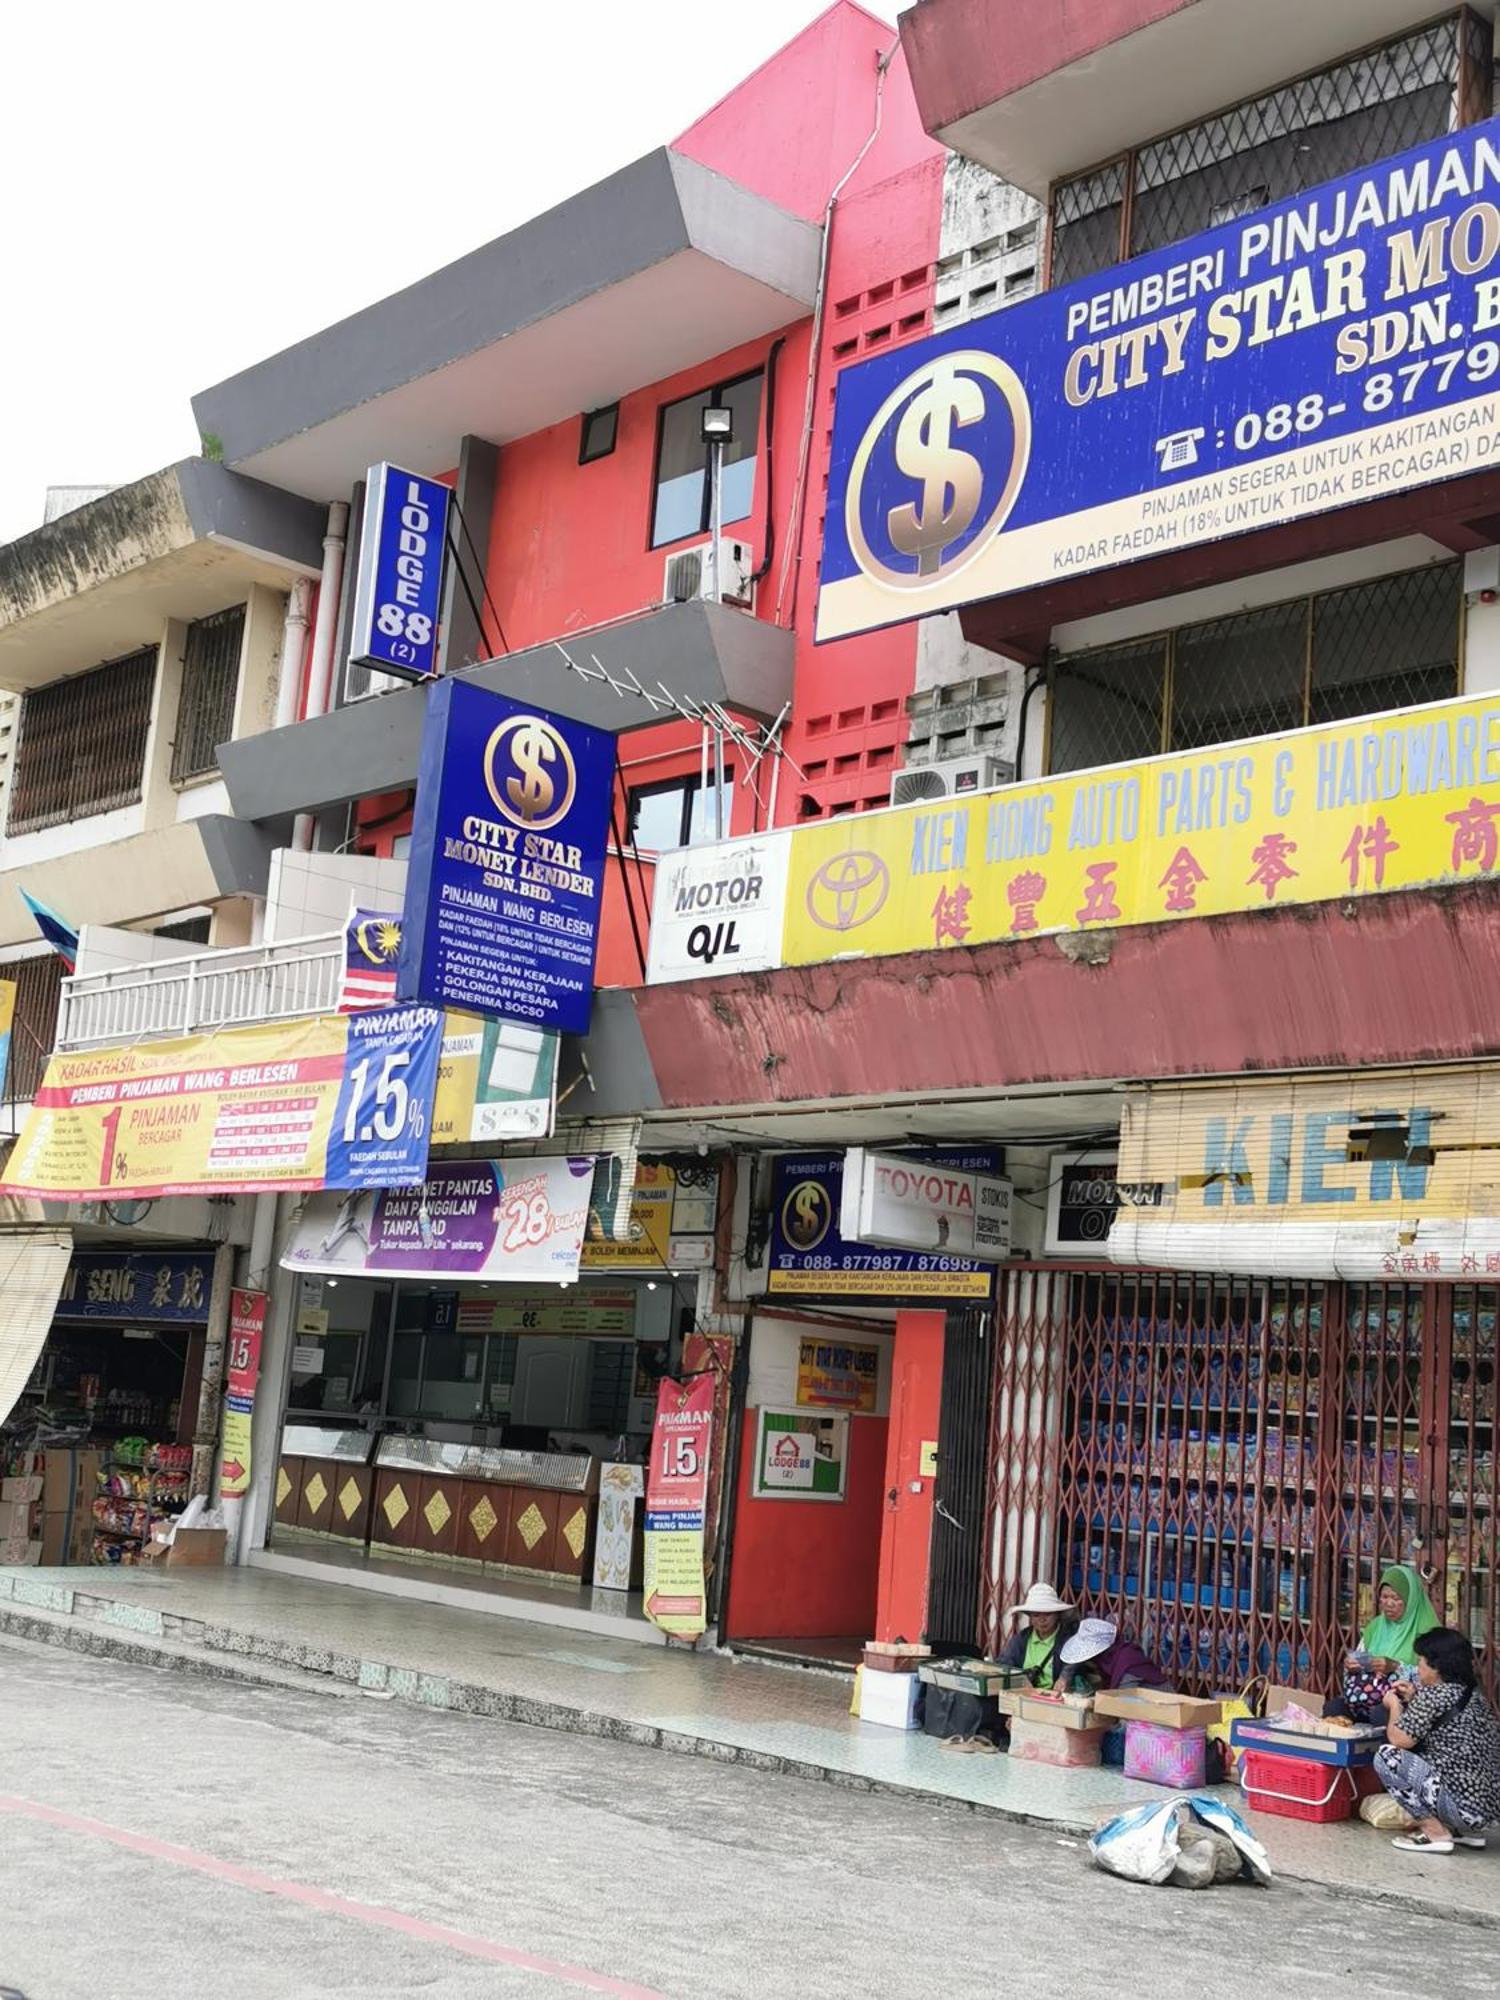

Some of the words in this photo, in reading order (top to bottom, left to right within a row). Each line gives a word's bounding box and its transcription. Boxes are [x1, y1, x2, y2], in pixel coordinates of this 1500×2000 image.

[1067, 250, 1225, 341] PEMBERI
[1239, 136, 1500, 278] PINJAMAN
[1064, 308, 1196, 406] CITY
[1205, 249, 1367, 362] STAR
[1335, 292, 1463, 377] SDN.
[1142, 484, 1223, 520] PINJAMAN
[1228, 460, 1298, 494] SEGERA
[1303, 444, 1364, 477] UNTUK
[1370, 404, 1496, 456] KAKITANGAN
[1053, 535, 1109, 570] KADAR
[1112, 519, 1179, 554] FAEDAH
[1183, 509, 1221, 536] (18%
[1224, 493, 1285, 525] UNTUK
[1290, 479, 1346, 510] TIDAK
[1351, 442, 1470, 491] BERCAGAR)
[395, 481, 430, 608] LODGE
[377, 603, 433, 646] 88
[390, 641, 416, 664] (2)
[910, 809, 970, 876] KIEN
[986, 795, 1054, 865] HONG
[1068, 778, 1141, 851] AUTO
[1157, 757, 1255, 838] PARTS
[1271, 750, 1295, 818] &
[1315, 709, 1500, 811] HARDWARE
[463, 815, 521, 851] CITY
[524, 832, 583, 872] STAR
[443, 837, 518, 879] MONEY
[519, 860, 595, 899] LENDER
[483, 871, 519, 895] SDN.
[520, 883, 555, 904] BHD.
[675, 875, 763, 913] MOTOR
[439, 908, 465, 923] KADAR
[465, 914, 494, 930] FAEDAH
[511, 925, 533, 940] UNTUK
[534, 929, 554, 945] TIDAK
[442, 885, 499, 912] PINJAMAN
[502, 900, 535, 922] WANG
[539, 910, 594, 938] BERLESEN
[438, 920, 455, 932] DAN
[472, 927, 495, 943] UNTUK
[538, 943, 561, 957] UNTUK
[440, 936, 479, 954] PINJAMAN
[445, 963, 499, 984] PEKERJA
[501, 977, 548, 995] SWASTA
[446, 951, 522, 977] KAKITANGAN
[523, 968, 584, 992] KERAJAAN
[442, 987, 503, 1009] PENERIMA
[504, 1002, 545, 1019] SOCSO
[444, 975, 512, 999] GOLONGAN
[513, 991, 559, 1011] PESARA
[354, 1008, 438, 1037] PINJAMAN
[60, 1059, 102, 1080] KADAR
[102, 1055, 136, 1076] HASIL
[70, 1087, 116, 1104] PEMBERI
[120, 1078, 179, 1099] PINJAMAN
[183, 1071, 224, 1090] WANG
[229, 1064, 297, 1086] BERLESEN
[129, 1103, 201, 1129] PINJAMAN
[138, 1129, 183, 1144] BERCAGAR
[785, 1163, 826, 1175] PEMBERI
[1203, 1106, 1434, 1206] KIEN
[446, 1179, 493, 1196] PANTAS
[877, 1167, 973, 1209] TOYOTA
[384, 1201, 409, 1216] DAN
[502, 1194, 549, 1253] 28
[383, 1220, 419, 1236] TANPA
[842, 1255, 903, 1271] 877987
[87, 1268, 136, 1302] SENG
